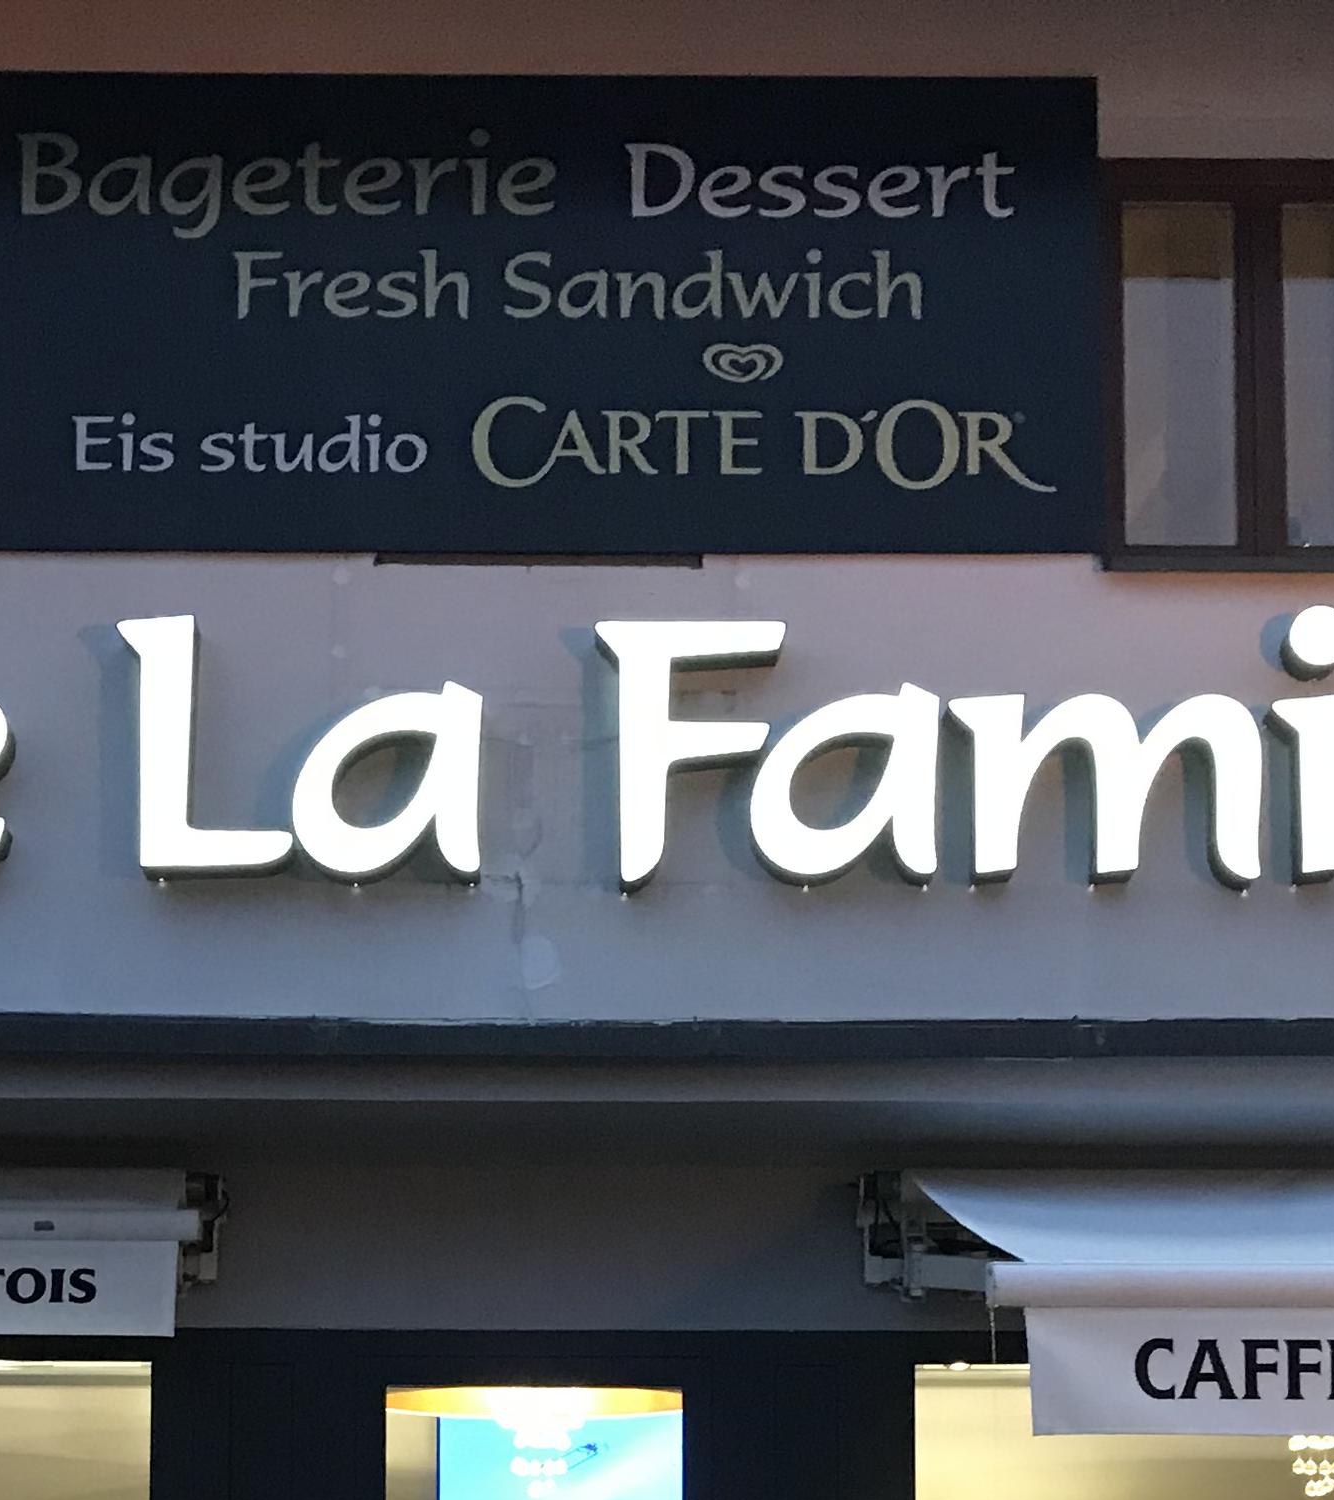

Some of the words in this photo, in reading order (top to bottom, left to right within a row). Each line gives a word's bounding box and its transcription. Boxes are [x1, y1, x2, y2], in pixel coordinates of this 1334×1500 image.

[17, 129, 556, 238] Bageterie
[626, 142, 1016, 220] Dessert
[233, 250, 468, 320] Fresh
[504, 249, 923, 319] Sandwich
[72, 414, 175, 473] Eis
[199, 416, 428, 473] studio
[471, 396, 763, 489] CARTE
[113, 613, 485, 878] La
